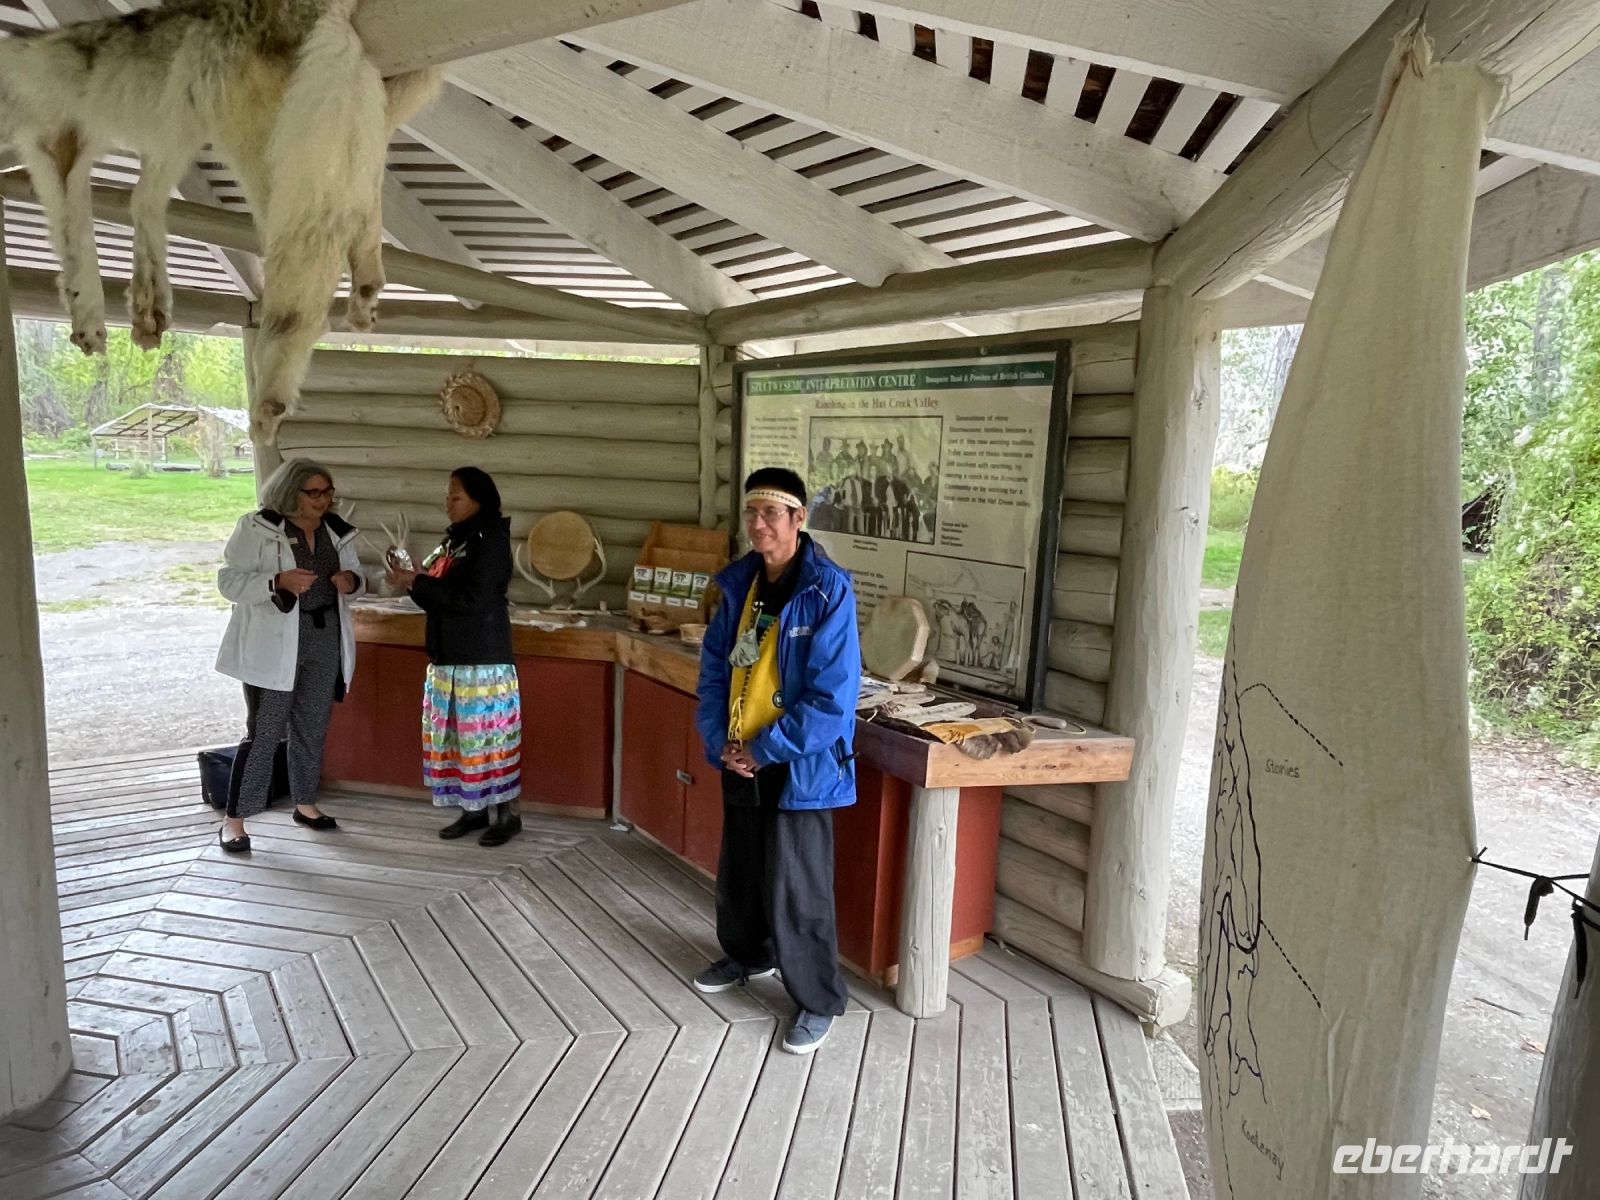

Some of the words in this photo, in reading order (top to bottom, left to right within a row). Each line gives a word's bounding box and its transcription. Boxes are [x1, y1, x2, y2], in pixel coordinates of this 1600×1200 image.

[806, 376, 876, 391] INTERPRETATION
[878, 373, 916, 388] CENTRE
[872, 398, 886, 408] Hat
[888, 397, 911, 408] Creek
[914, 396, 939, 409] Valley
[1264, 758, 1300, 778] Stories
